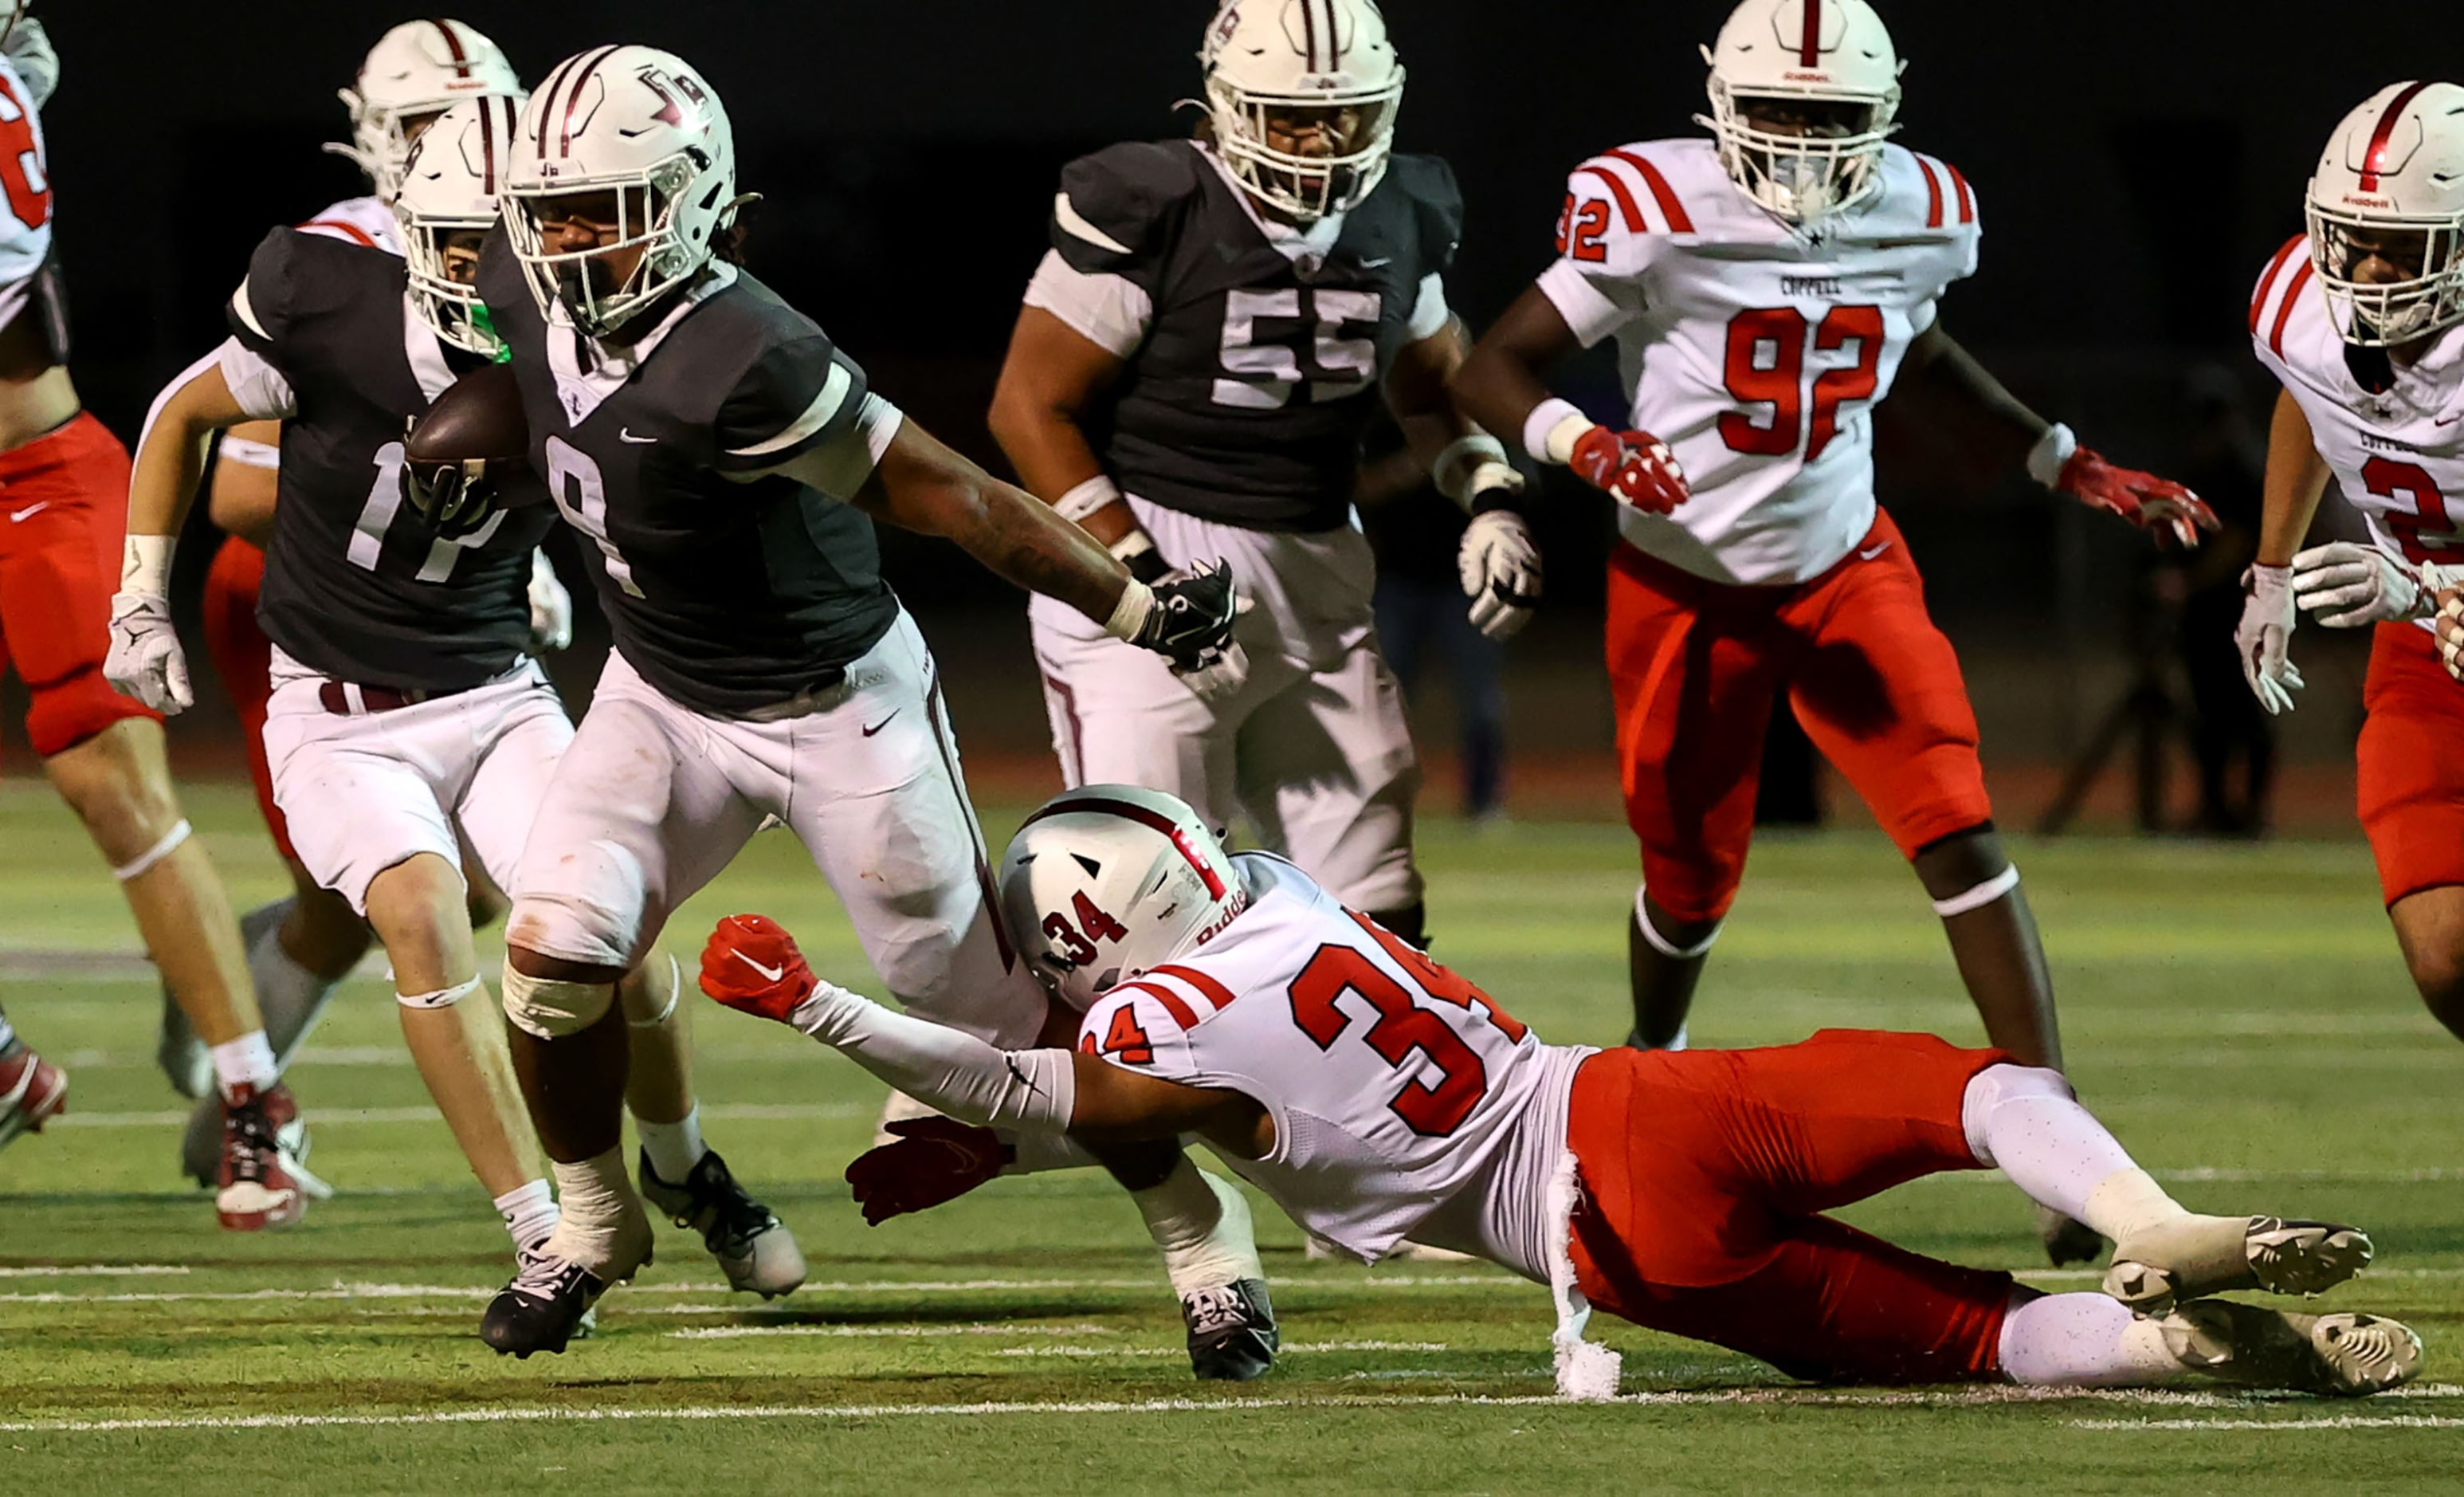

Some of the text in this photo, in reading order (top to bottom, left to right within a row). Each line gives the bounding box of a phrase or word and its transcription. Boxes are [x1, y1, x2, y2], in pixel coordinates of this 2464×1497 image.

[1211, 289, 1381, 408] 55
[1717, 305, 1884, 462] 92
[545, 434, 646, 599] 9
[1042, 889, 1129, 966] 34
